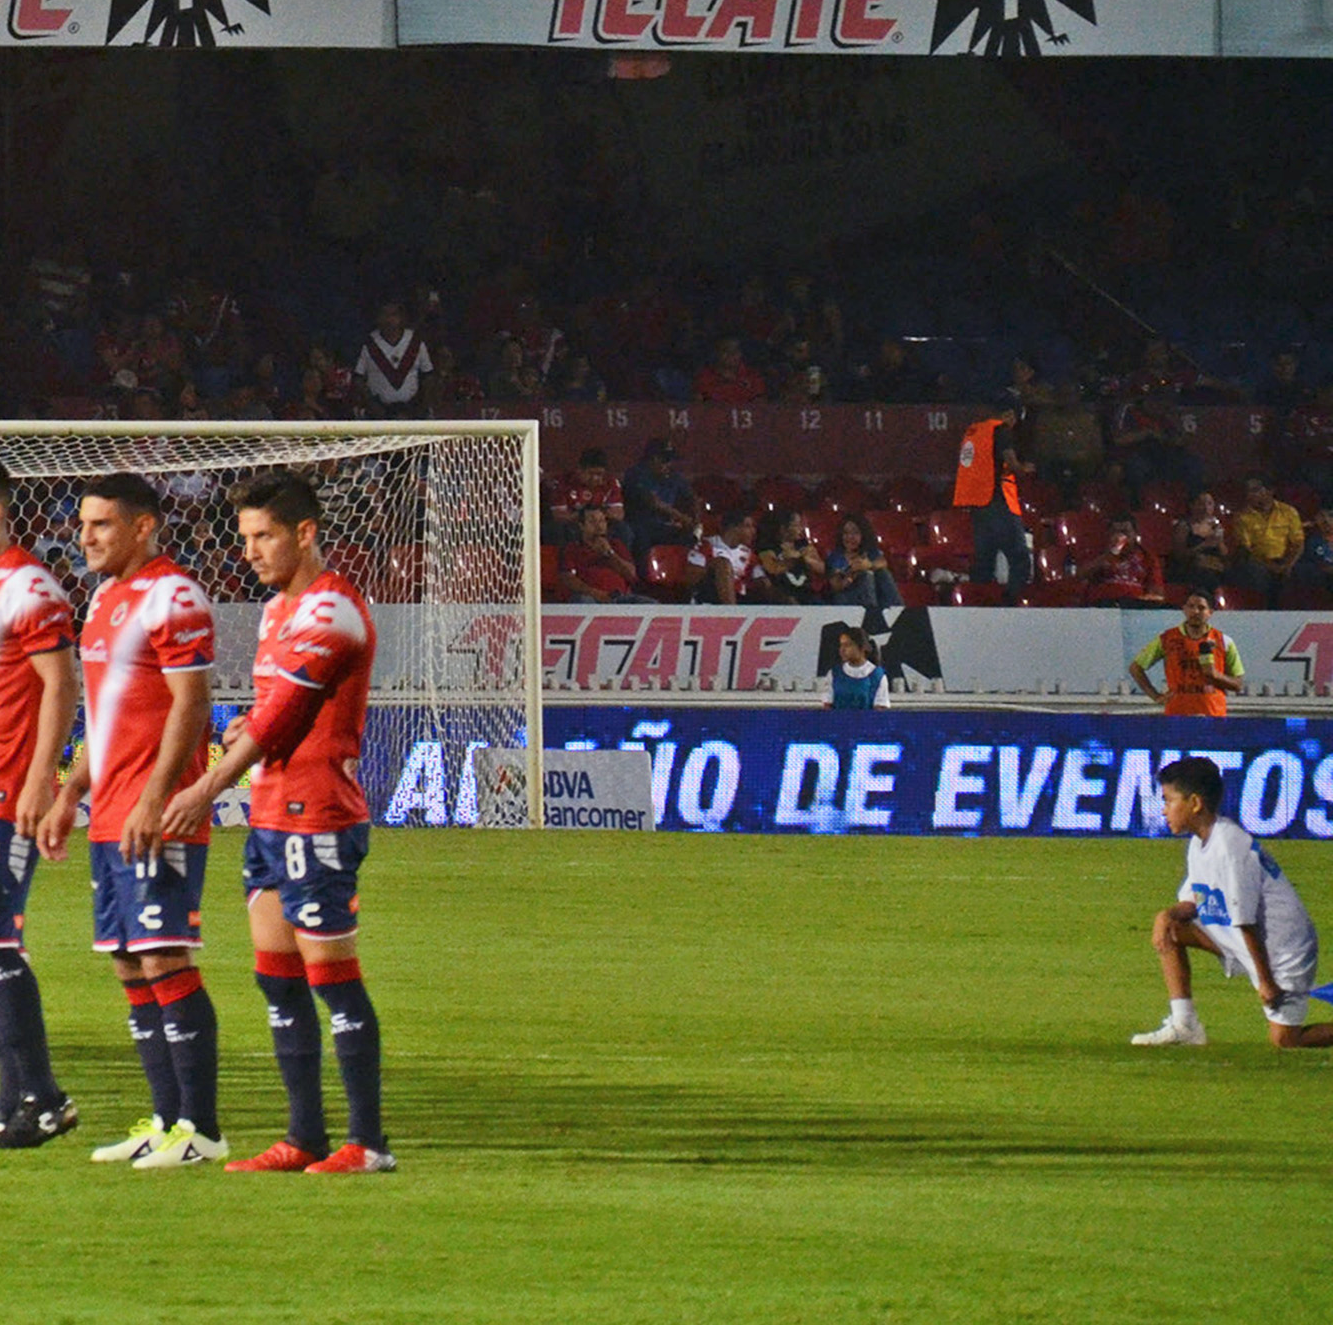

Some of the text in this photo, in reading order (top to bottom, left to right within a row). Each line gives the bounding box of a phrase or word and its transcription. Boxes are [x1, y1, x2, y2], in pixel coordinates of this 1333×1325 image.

[542, 407, 563, 428] 16
[606, 408, 628, 427] 15
[668, 409, 690, 429] 14
[731, 409, 753, 428] 13
[800, 410, 821, 429] 12
[864, 410, 883, 430] 11
[446, 614, 802, 691] TECATE
[773, 742, 903, 831] DE
[284, 833, 308, 881] 8
